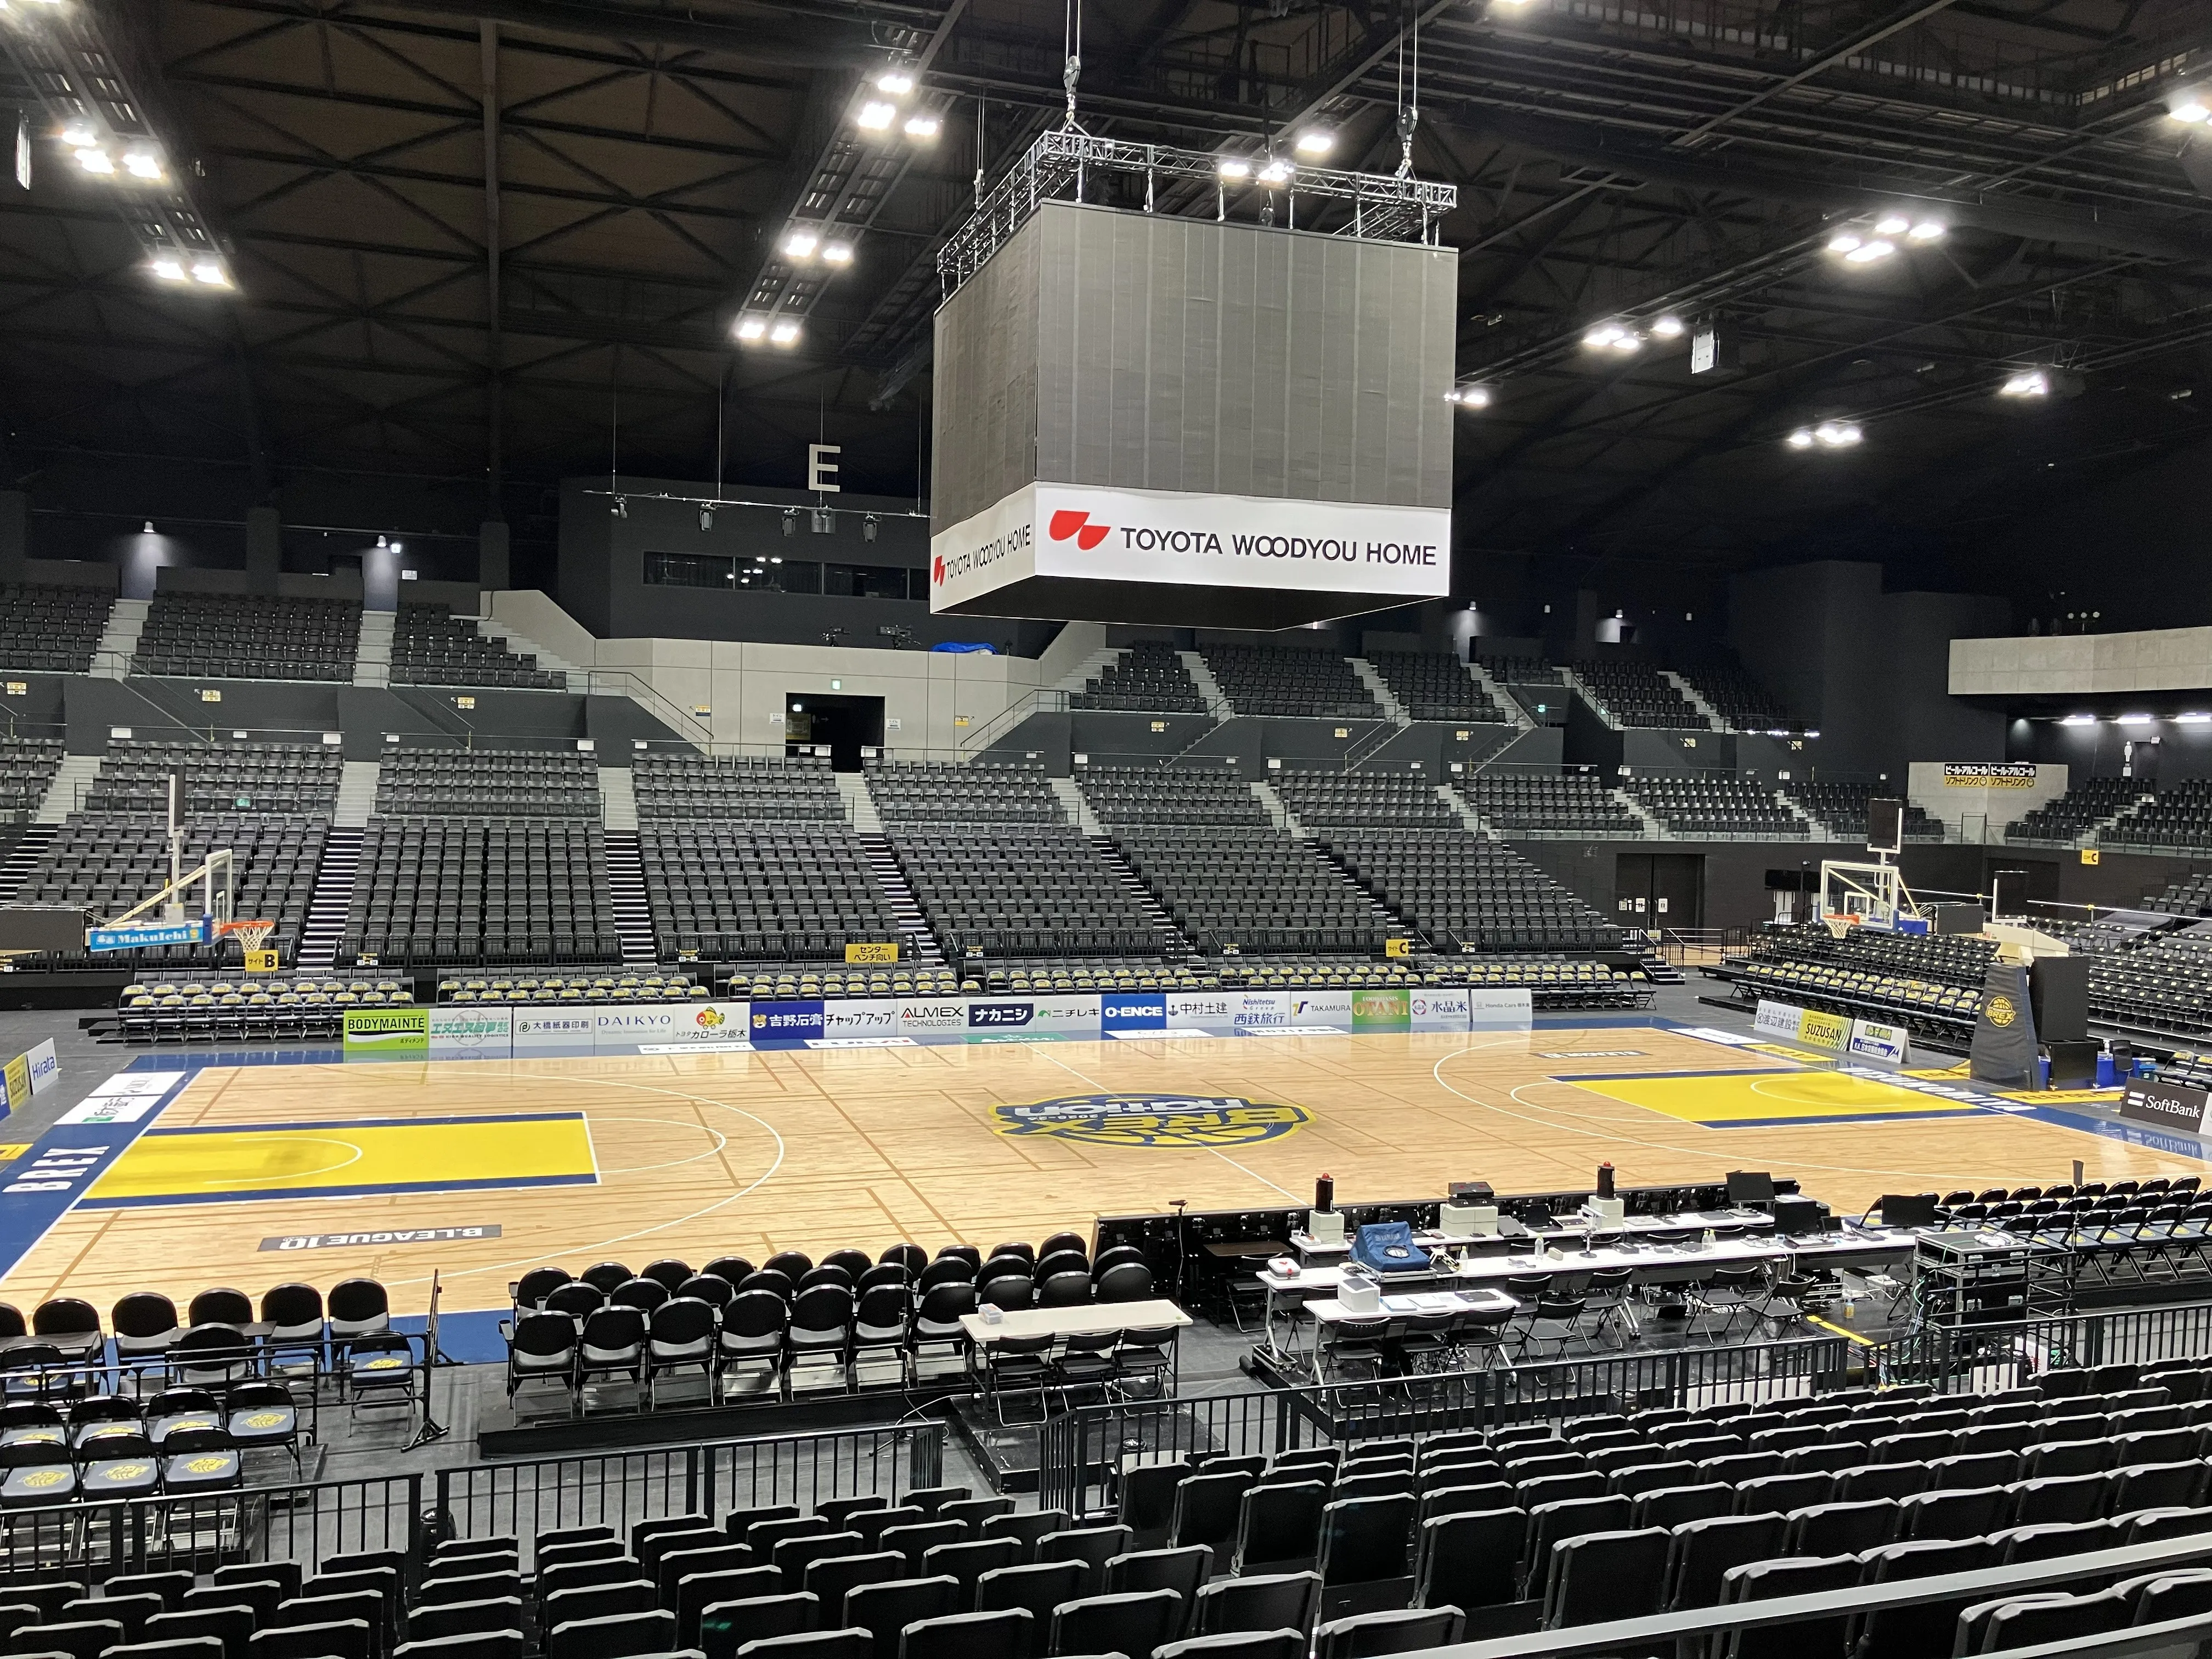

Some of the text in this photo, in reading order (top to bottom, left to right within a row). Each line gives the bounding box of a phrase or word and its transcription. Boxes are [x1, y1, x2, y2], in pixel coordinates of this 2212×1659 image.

[809, 444, 840, 493] E
[946, 523, 1031, 580] TOYOTA WOODYOU HOME
[1120, 527, 1437, 566] TOYOTA WOODYOU HOME
[1946, 777, 1978, 785] ソフトドリンク
[2091, 853, 2097, 862] C
[1399, 942, 1406, 953] C
[264, 954, 275, 967] B
[901, 1007, 963, 1018] ALMEX
[1052, 1008, 1099, 1018] ニチレキ
[1180, 1002, 1228, 1014] 中村土建
[1353, 1001, 1408, 1016] OTANI
[1431, 1001, 1467, 1013] 水晶米
[1987, 1009, 2013, 1019] BREX
[598, 1015, 670, 1026] DAIKYO
[769, 1013, 823, 1027] 吉野石膏
[826, 1011, 895, 1026] チャップアップ
[975, 1008, 1028, 1022] ナカニシ
[1234, 1012, 1285, 1025] 西鉄旅行
[348, 1015, 425, 1031] BODYMAINTÉ
[533, 1020, 589, 1029] 大橋紙器印刷
[675, 1029, 747, 1040] トヨタカローラ栃木
[1805, 1023, 1842, 1041] SUZUSAN
[32, 1056, 55, 1081] Hirata
[1837, 1067, 2037, 1111] UTSUNOMIYA
[1014, 1099, 1244, 1117] nation
[2145, 1095, 2200, 1119] SoftBank
[1020, 1108, 1300, 1133] BREX
[2, 1146, 110, 1193] BREX
[279, 1227, 483, 1249] B.LEAGUE 10
